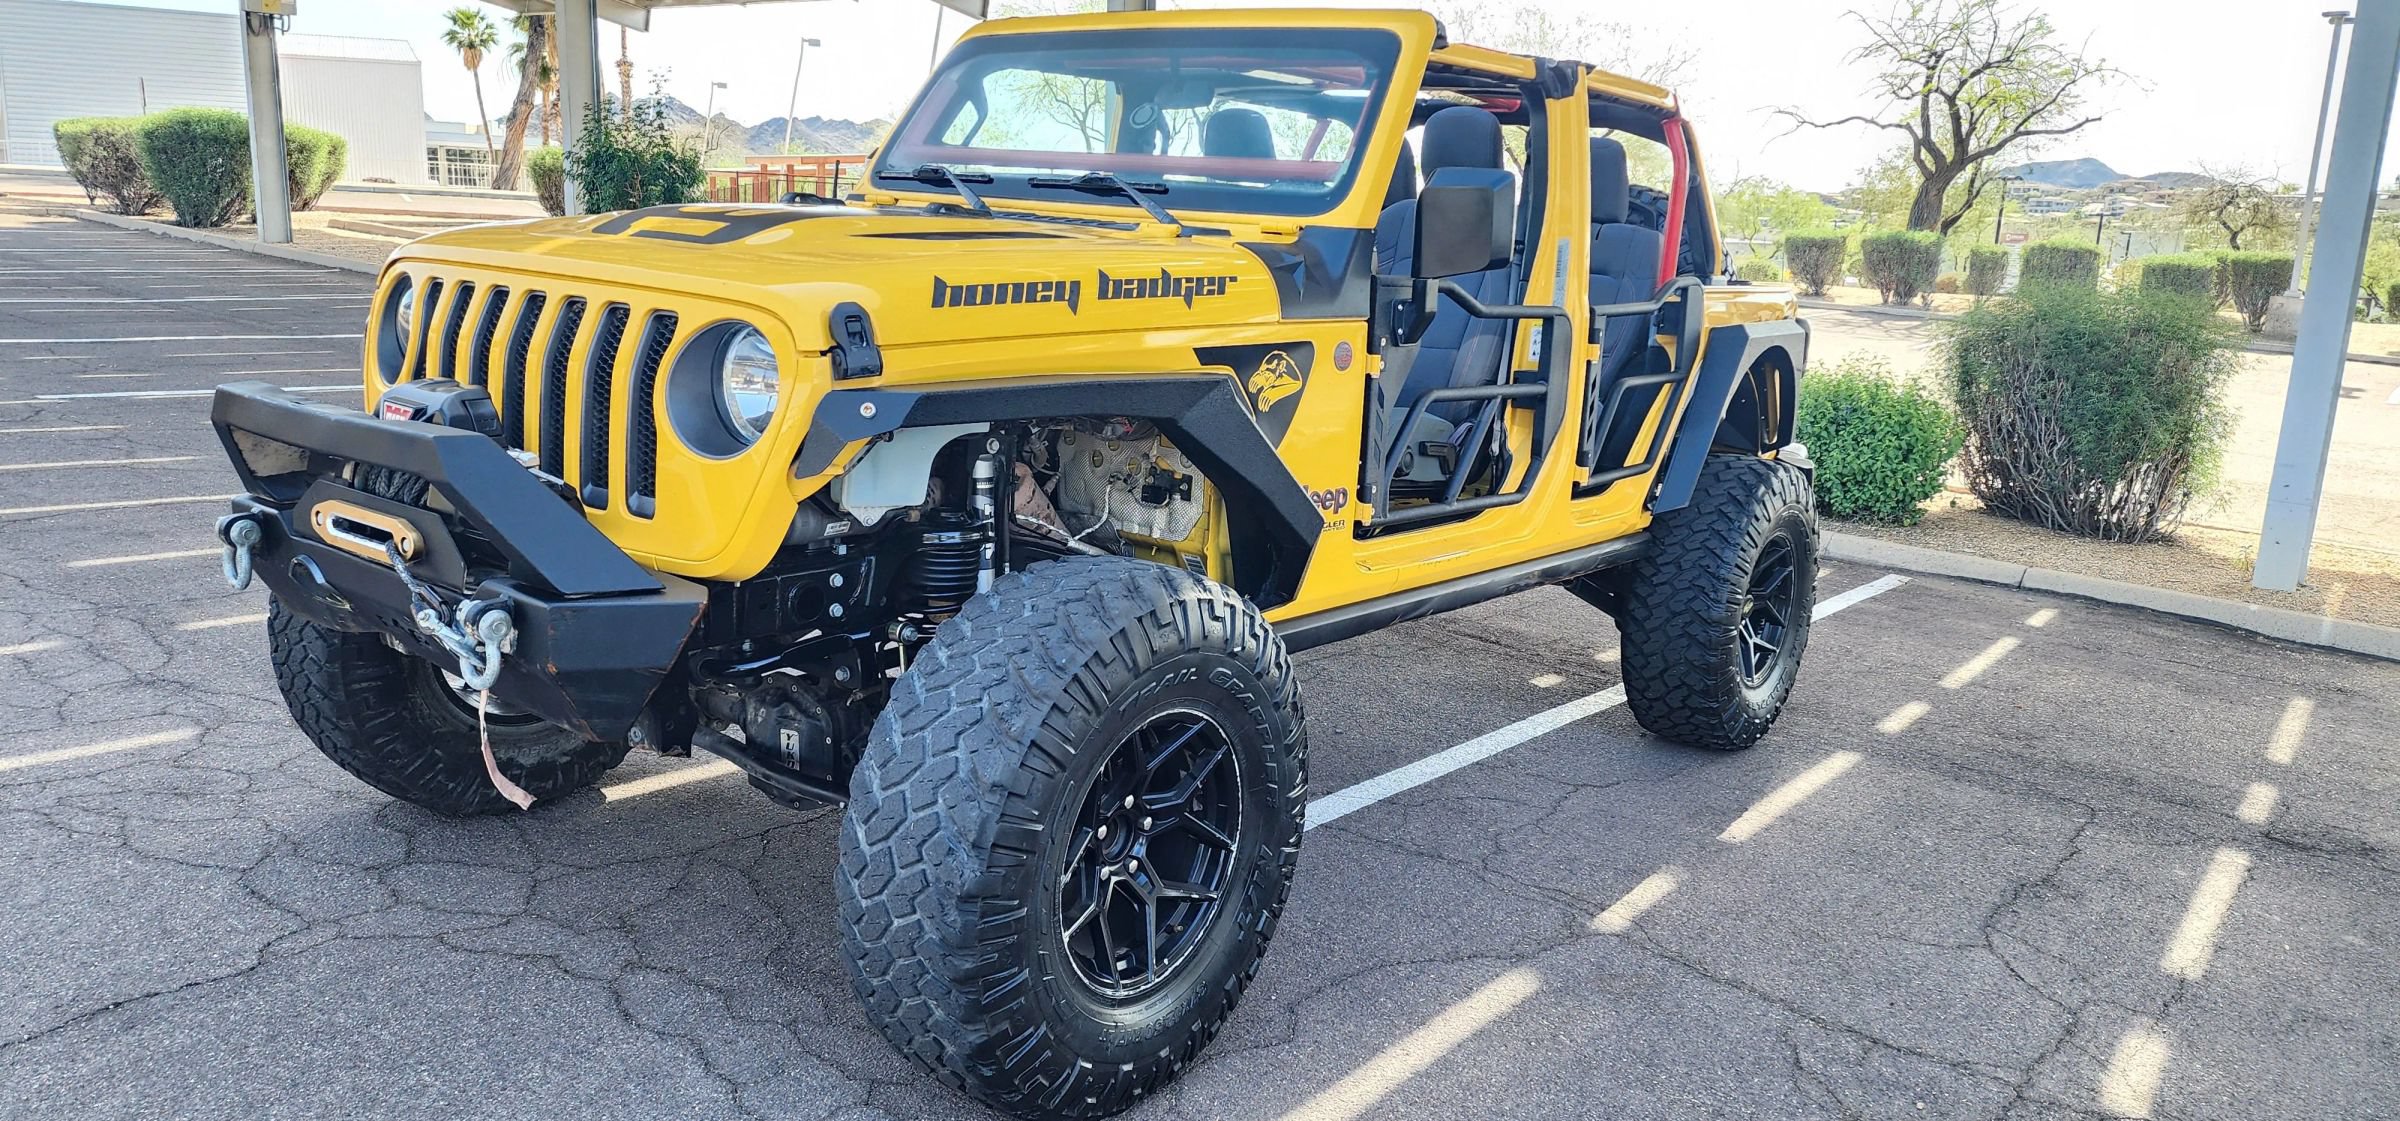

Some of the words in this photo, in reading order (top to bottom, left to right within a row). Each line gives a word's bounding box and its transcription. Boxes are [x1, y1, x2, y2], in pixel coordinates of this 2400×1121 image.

[932, 275, 1081, 316] honey
[1097, 267, 1238, 310] badger
[1118, 667, 1199, 713] TRAIL
[1207, 667, 1281, 810] GRAPPLER
